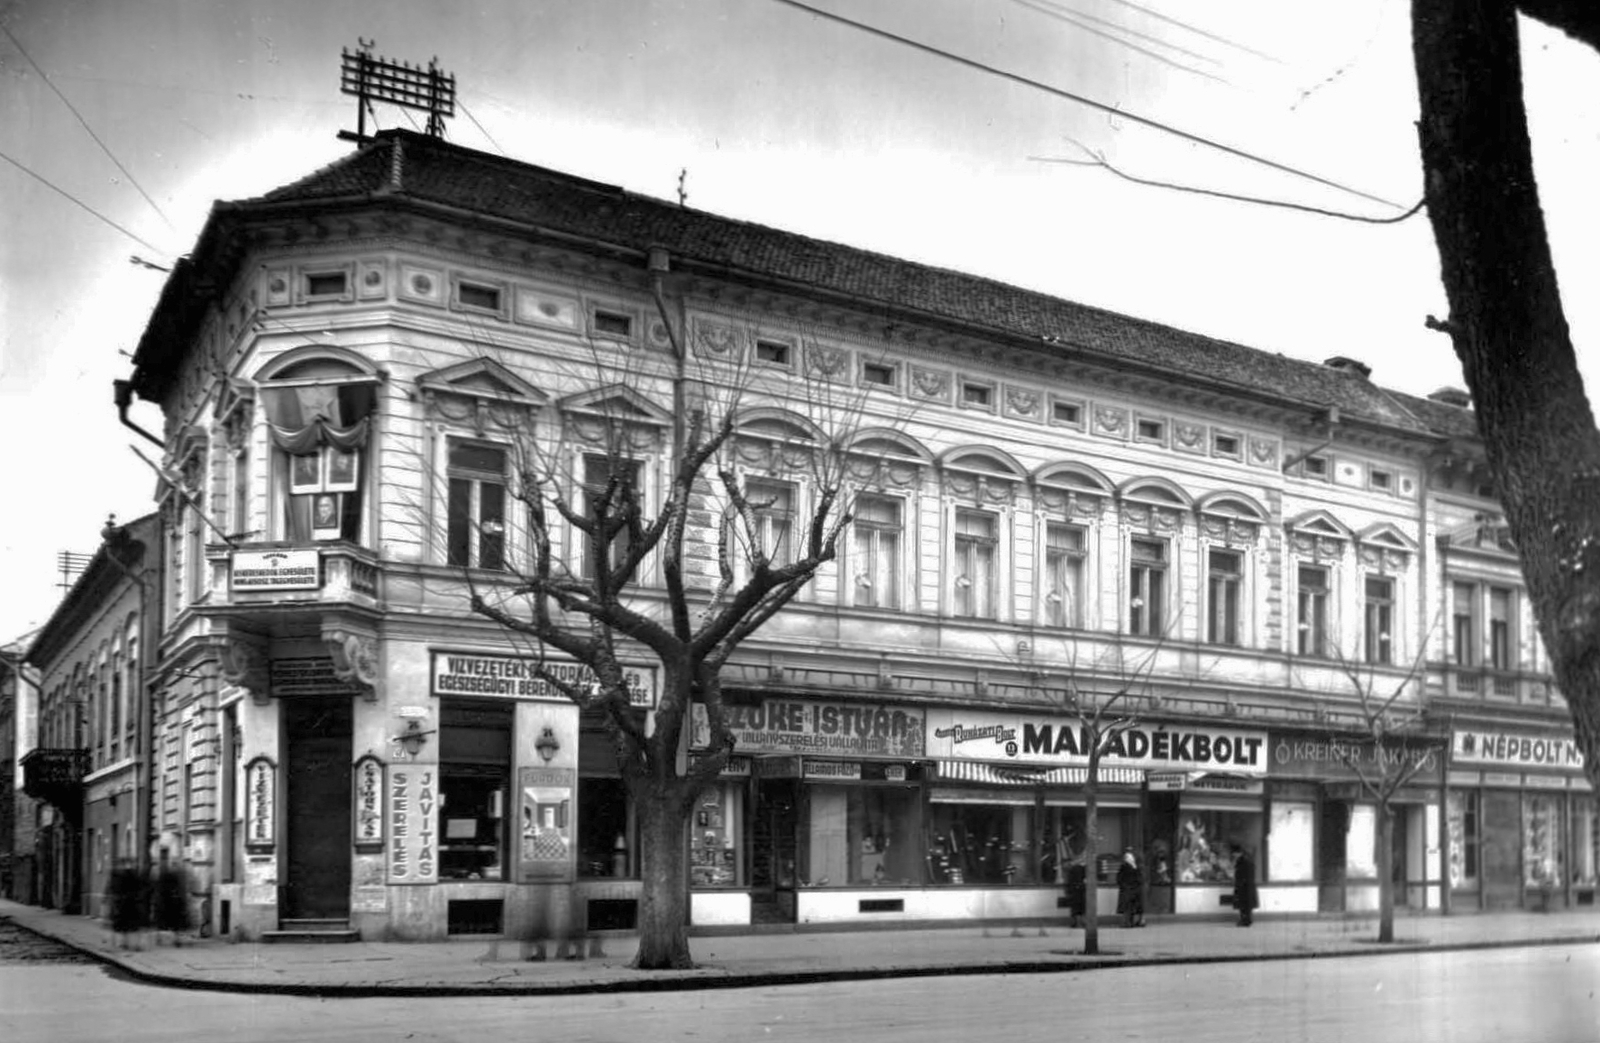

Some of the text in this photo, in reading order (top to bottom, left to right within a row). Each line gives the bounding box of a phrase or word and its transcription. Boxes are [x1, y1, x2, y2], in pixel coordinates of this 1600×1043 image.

[812, 703, 908, 738] ISTVÁN
[1482, 734, 1562, 763] NÉPBOLT
[393, 772, 408, 877] SZERELÉS
